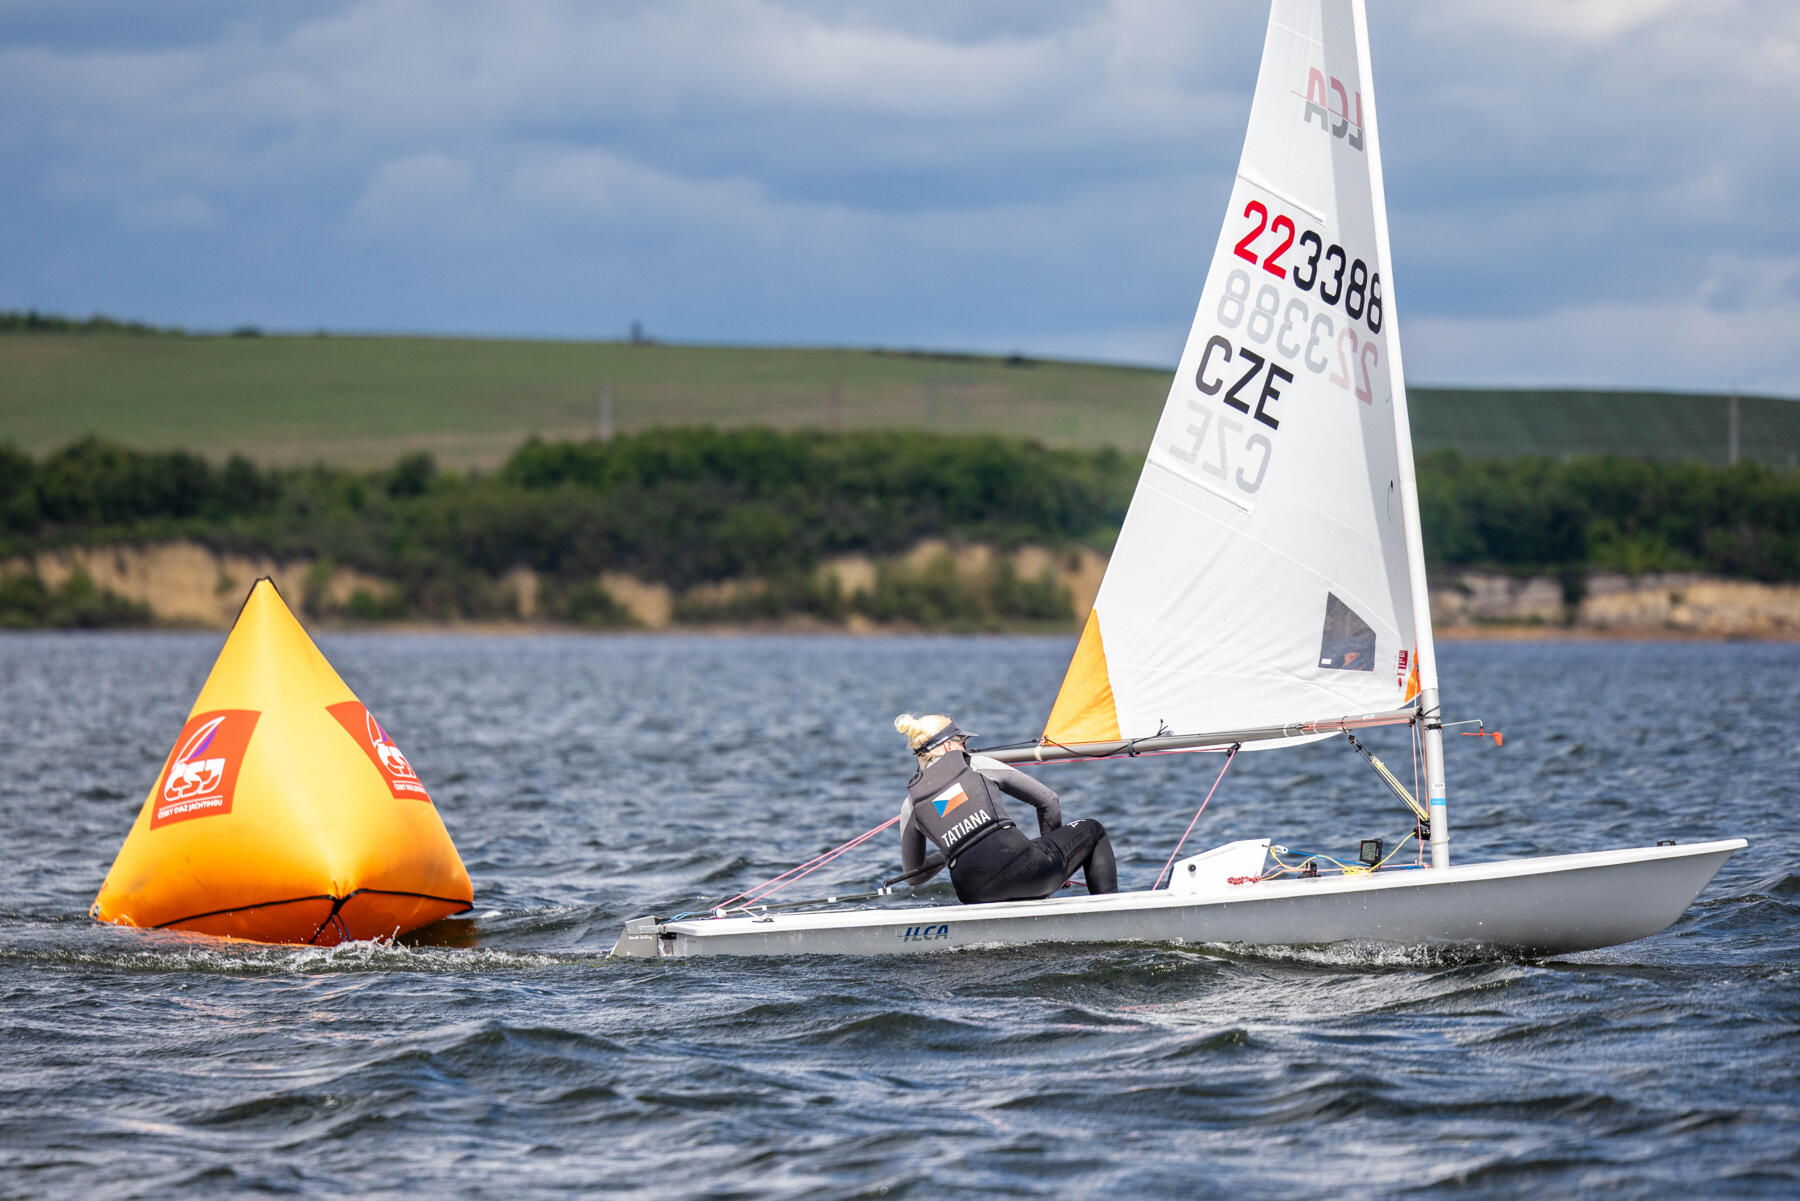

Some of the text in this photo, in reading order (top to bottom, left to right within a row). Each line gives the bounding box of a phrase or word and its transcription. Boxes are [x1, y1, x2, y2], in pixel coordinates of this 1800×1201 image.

[1233, 200, 1383, 334] 223388
[1195, 334, 1294, 430] CZE
[941, 808, 992, 847] TATIANA
[904, 924, 948, 943] ILCA
